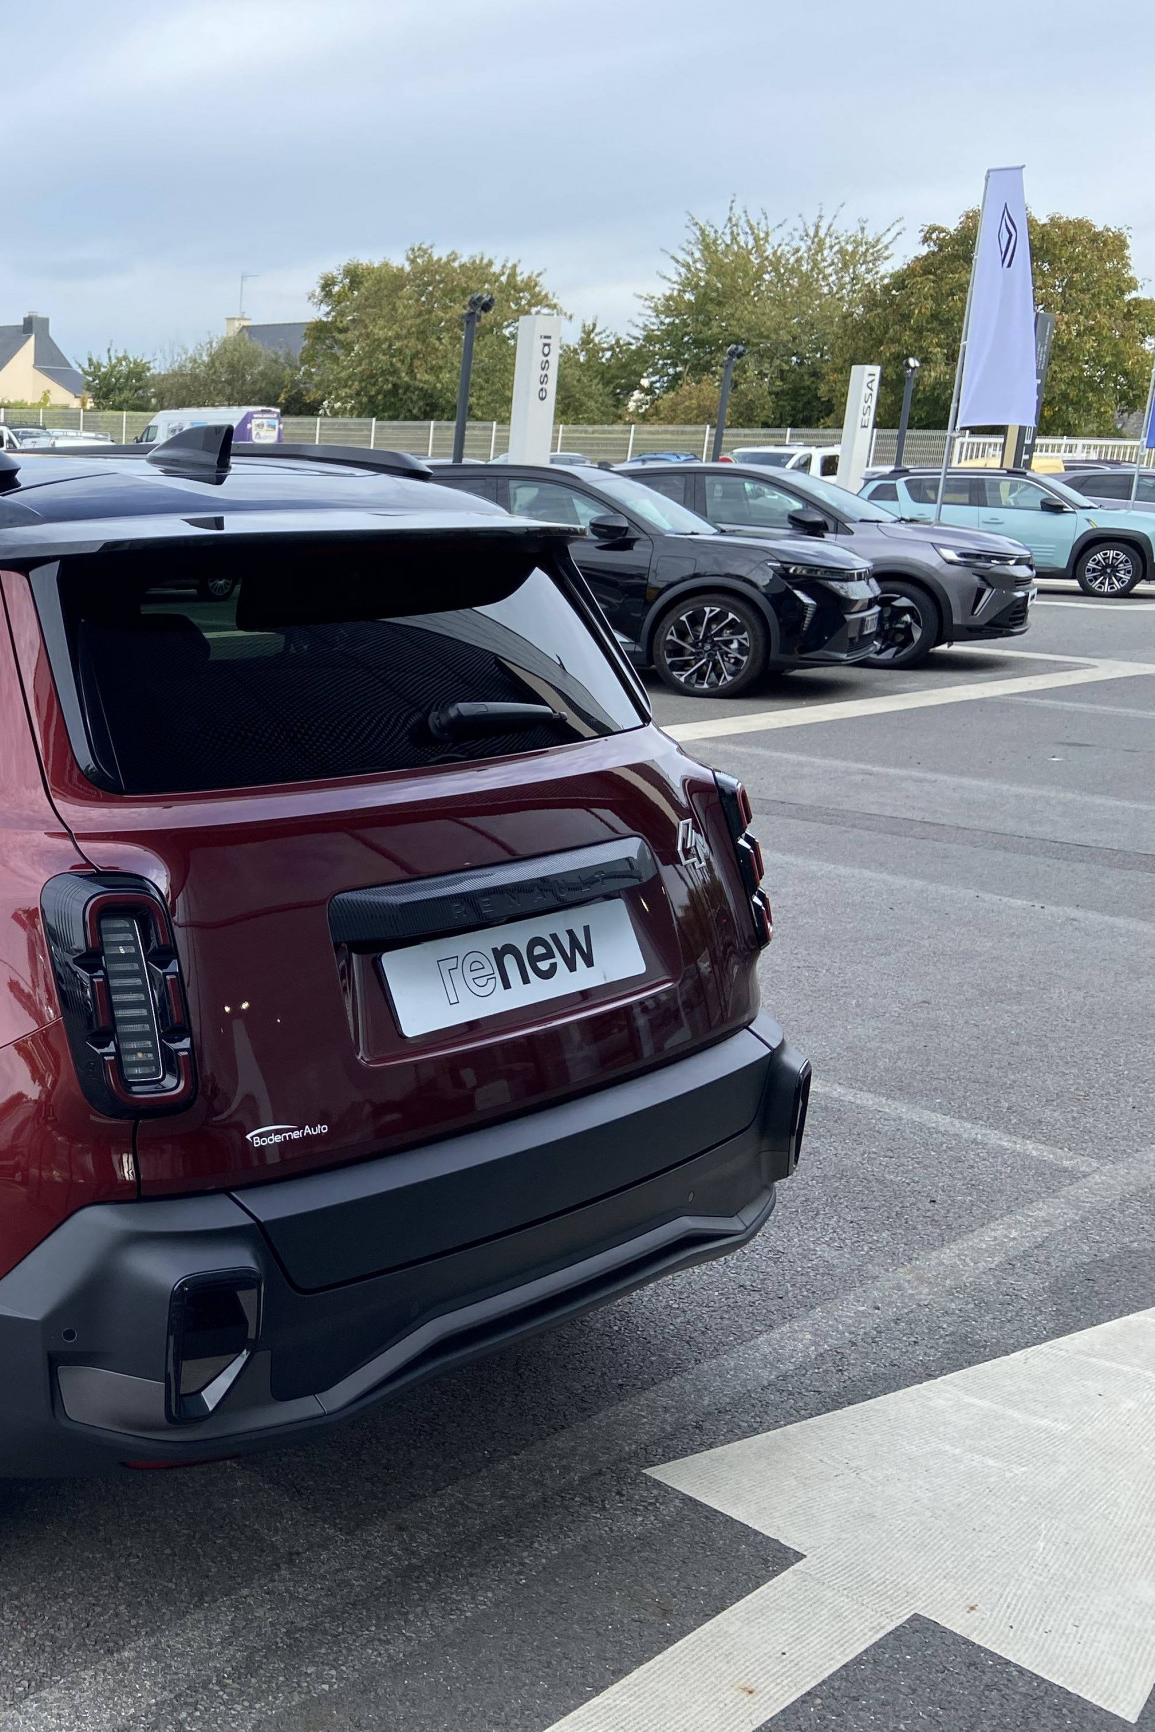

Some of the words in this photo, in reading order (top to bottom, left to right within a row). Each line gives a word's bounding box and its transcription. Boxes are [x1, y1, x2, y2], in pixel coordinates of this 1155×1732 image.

[538, 335, 552, 401] essai
[860, 373, 876, 429] ESSAI
[436, 934, 595, 1006] renew
